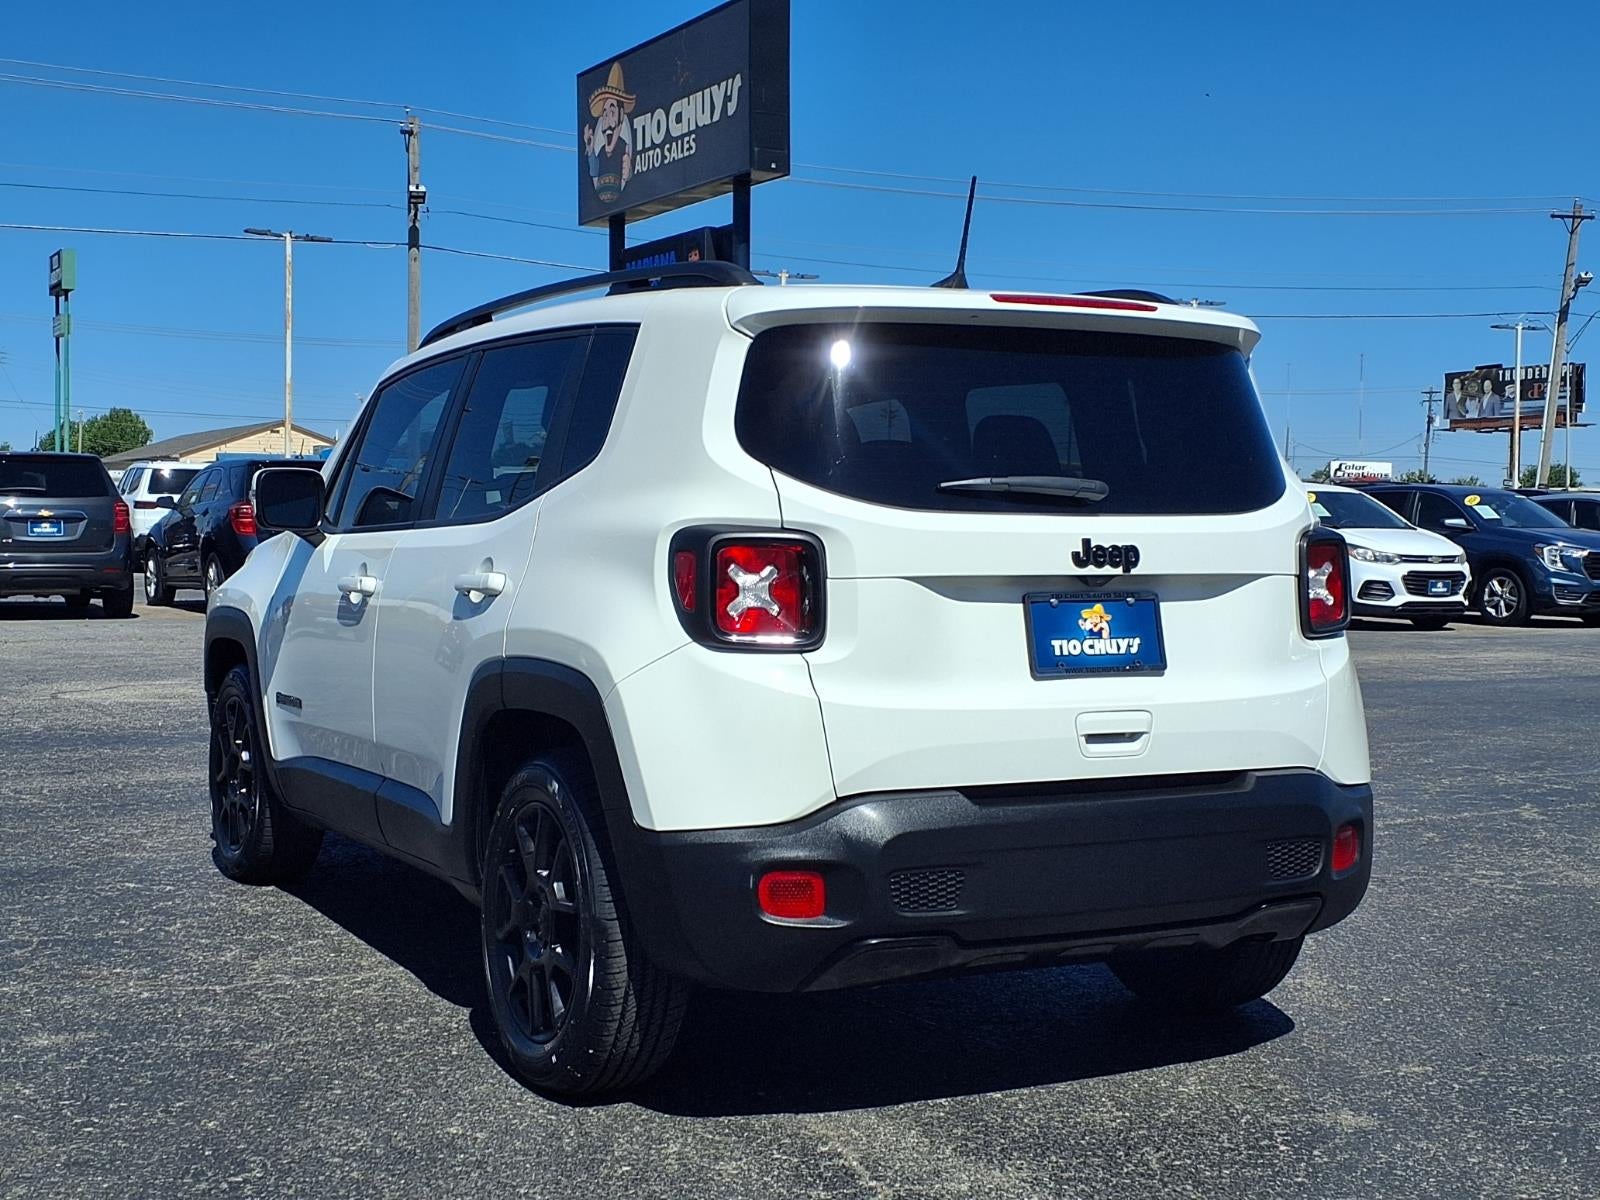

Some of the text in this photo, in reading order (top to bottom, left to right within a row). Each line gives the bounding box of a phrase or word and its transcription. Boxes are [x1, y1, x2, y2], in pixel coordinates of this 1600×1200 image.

[634, 73, 742, 151] TIO CHUY'S
[634, 134, 696, 174] AUTO SALES
[1071, 538, 1140, 573] Jeep
[1051, 637, 1141, 656] TIO CHUY'S
